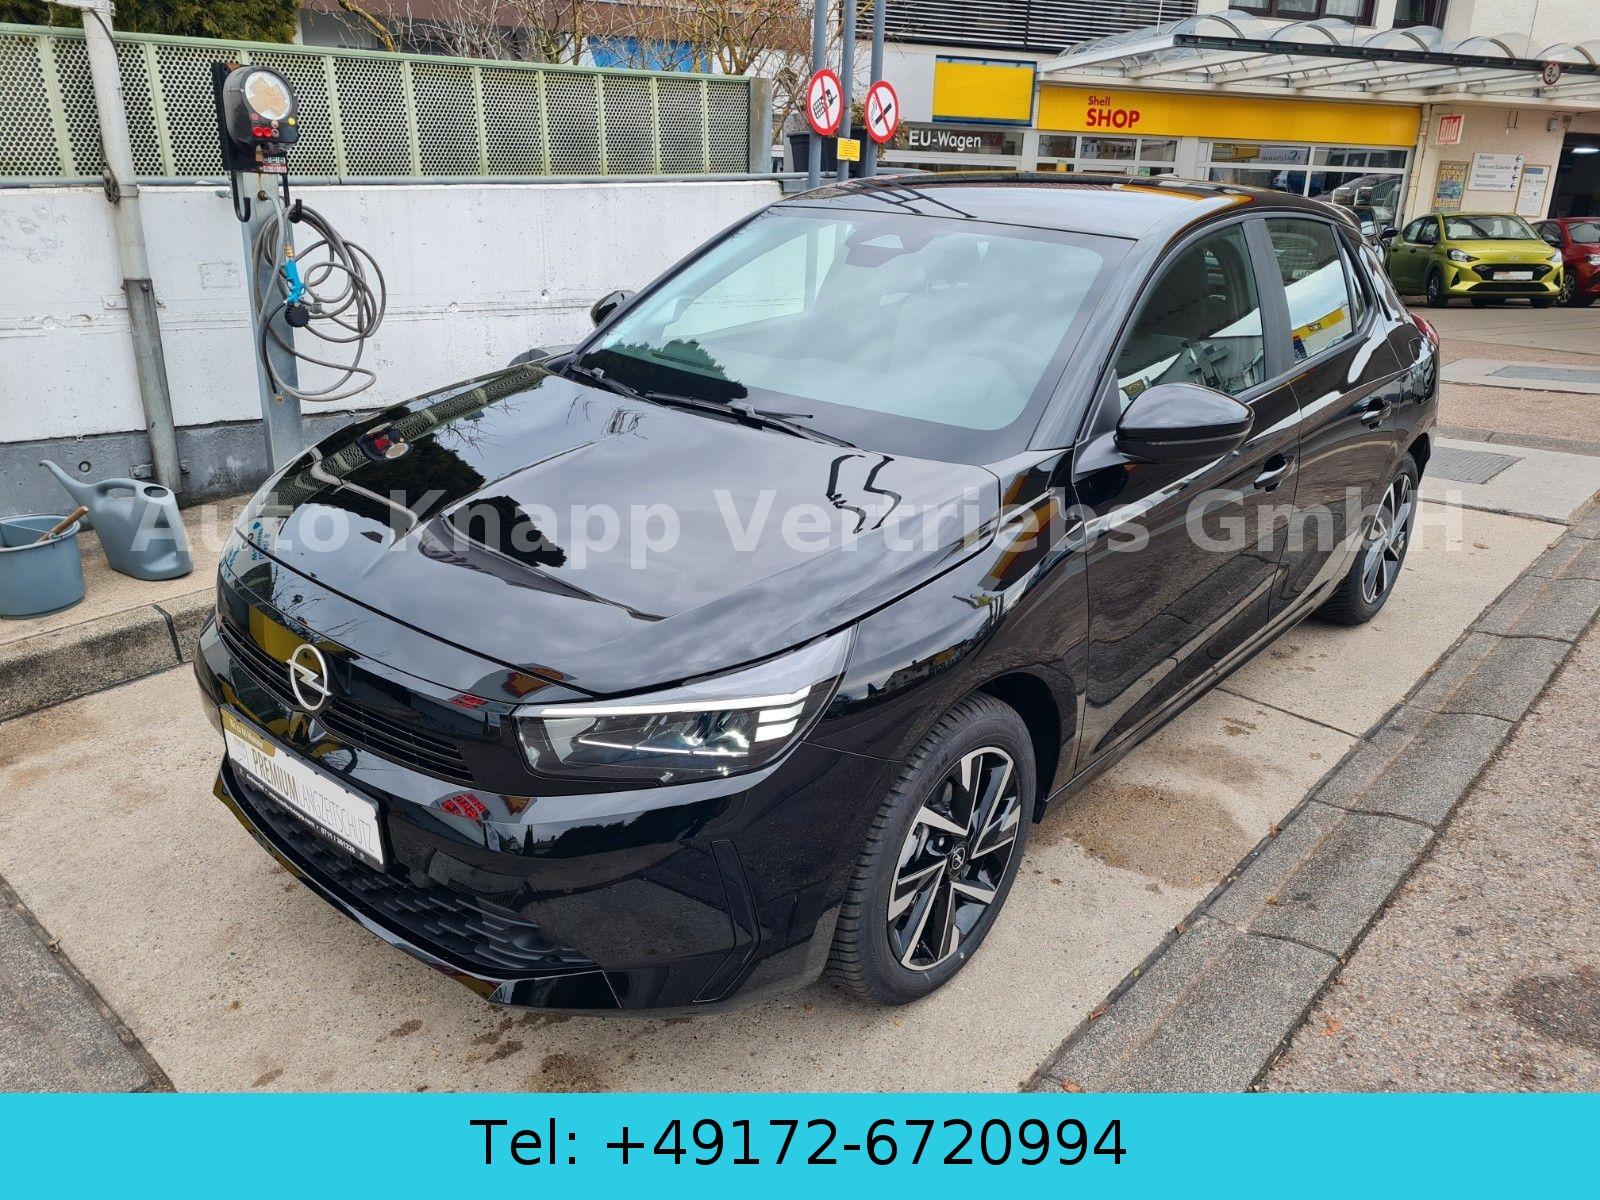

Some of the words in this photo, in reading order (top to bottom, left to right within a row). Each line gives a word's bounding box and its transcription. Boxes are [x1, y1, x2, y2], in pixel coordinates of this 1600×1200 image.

[1088, 95, 1111, 106] Shell
[1086, 108, 1140, 128] SHOP
[1438, 118, 1460, 142] Bild
[909, 130, 982, 151] EU-Wagen
